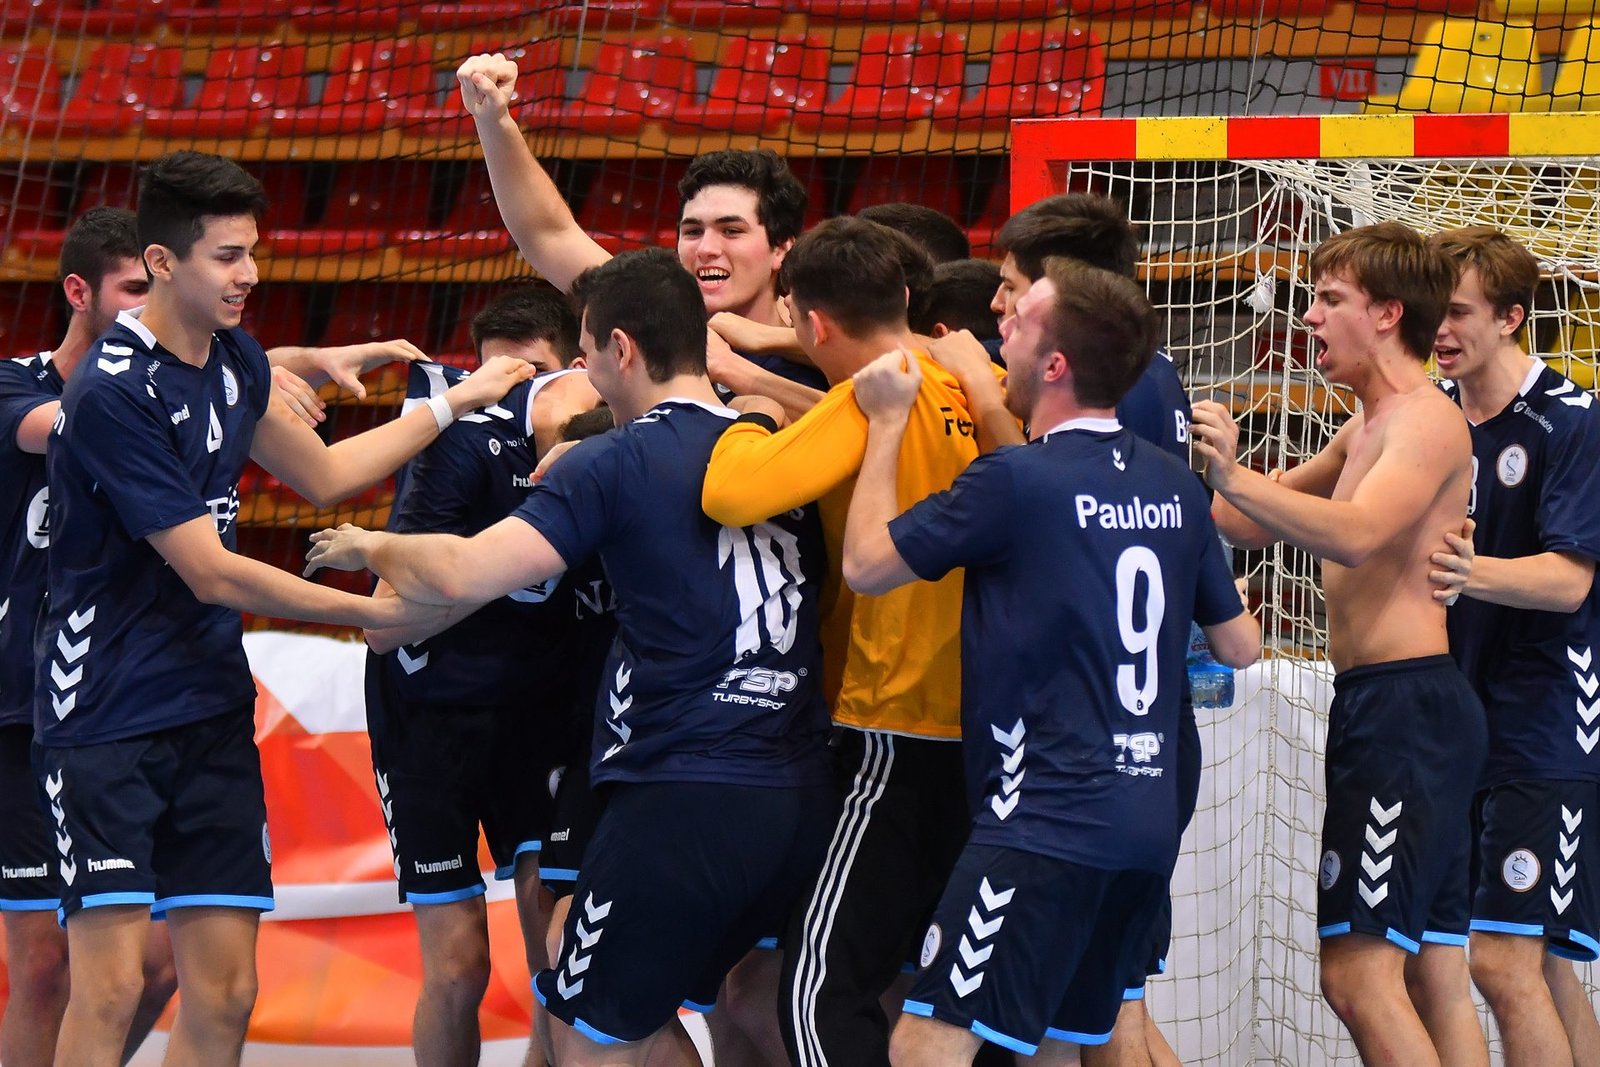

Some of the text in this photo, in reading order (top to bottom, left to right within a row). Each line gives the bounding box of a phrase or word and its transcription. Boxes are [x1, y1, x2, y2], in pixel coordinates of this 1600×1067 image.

[1075, 494, 1182, 529] Pauloni
[1116, 545, 1165, 716] 9
[1, 862, 48, 879] hummel
[415, 854, 463, 874] hummel
